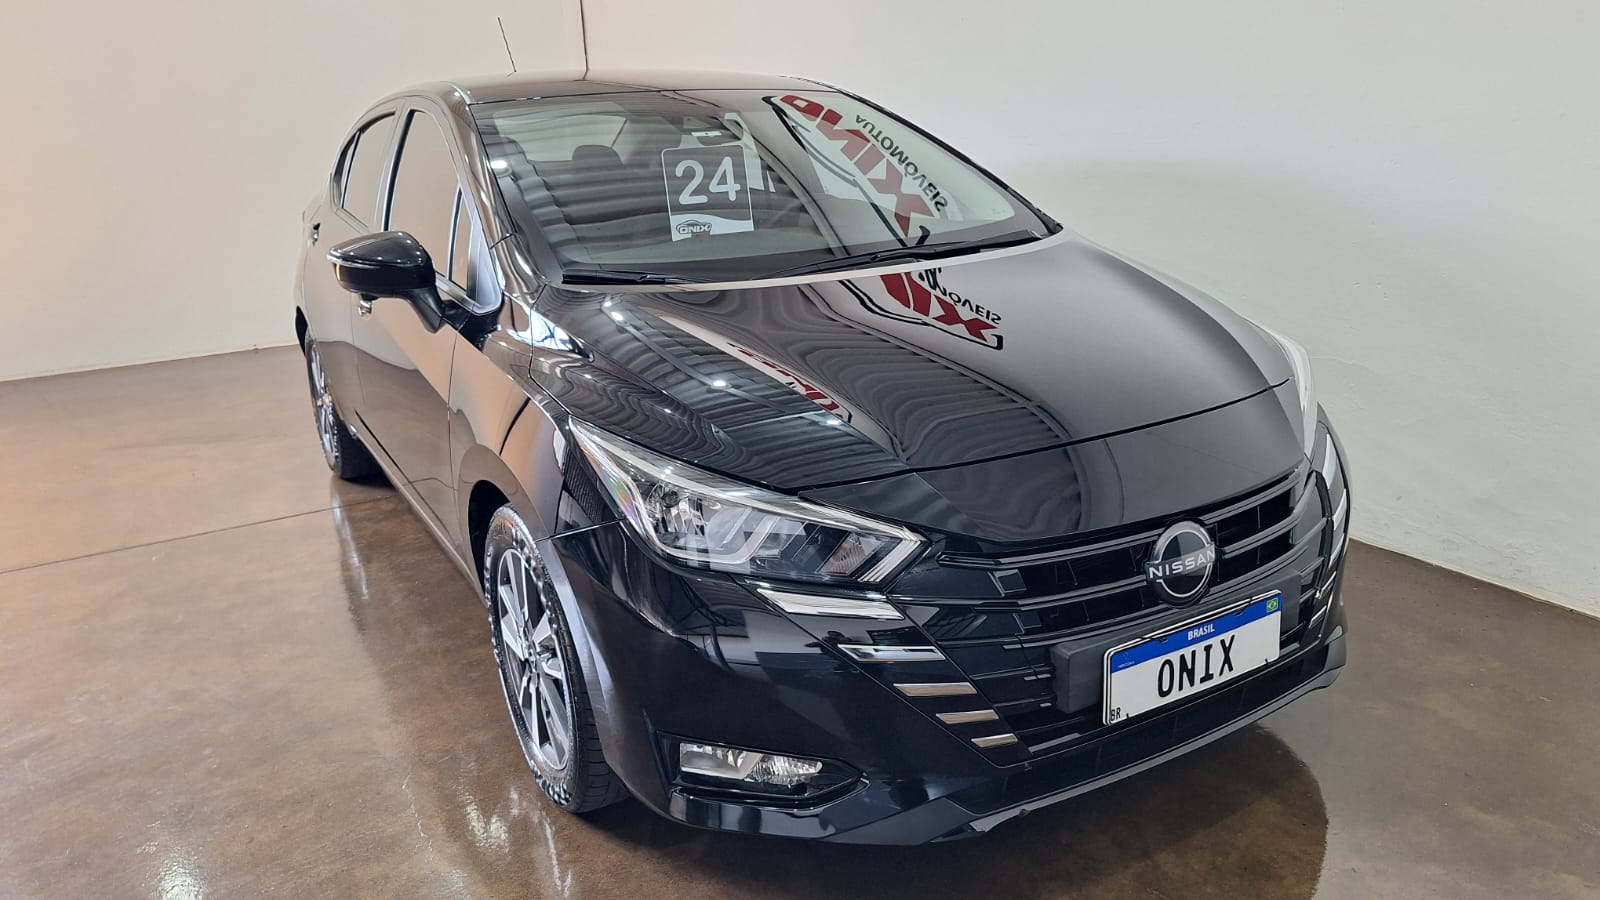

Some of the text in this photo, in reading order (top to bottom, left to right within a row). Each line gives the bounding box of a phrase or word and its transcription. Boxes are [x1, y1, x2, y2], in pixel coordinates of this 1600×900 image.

[675, 156, 741, 205] 24
[679, 223, 712, 234] ONIX
[1148, 550, 1215, 579] NISSAN
[1188, 623, 1215, 640] BRASIL
[1157, 635, 1235, 698] ONIX
[1110, 706, 1121, 721] BR
